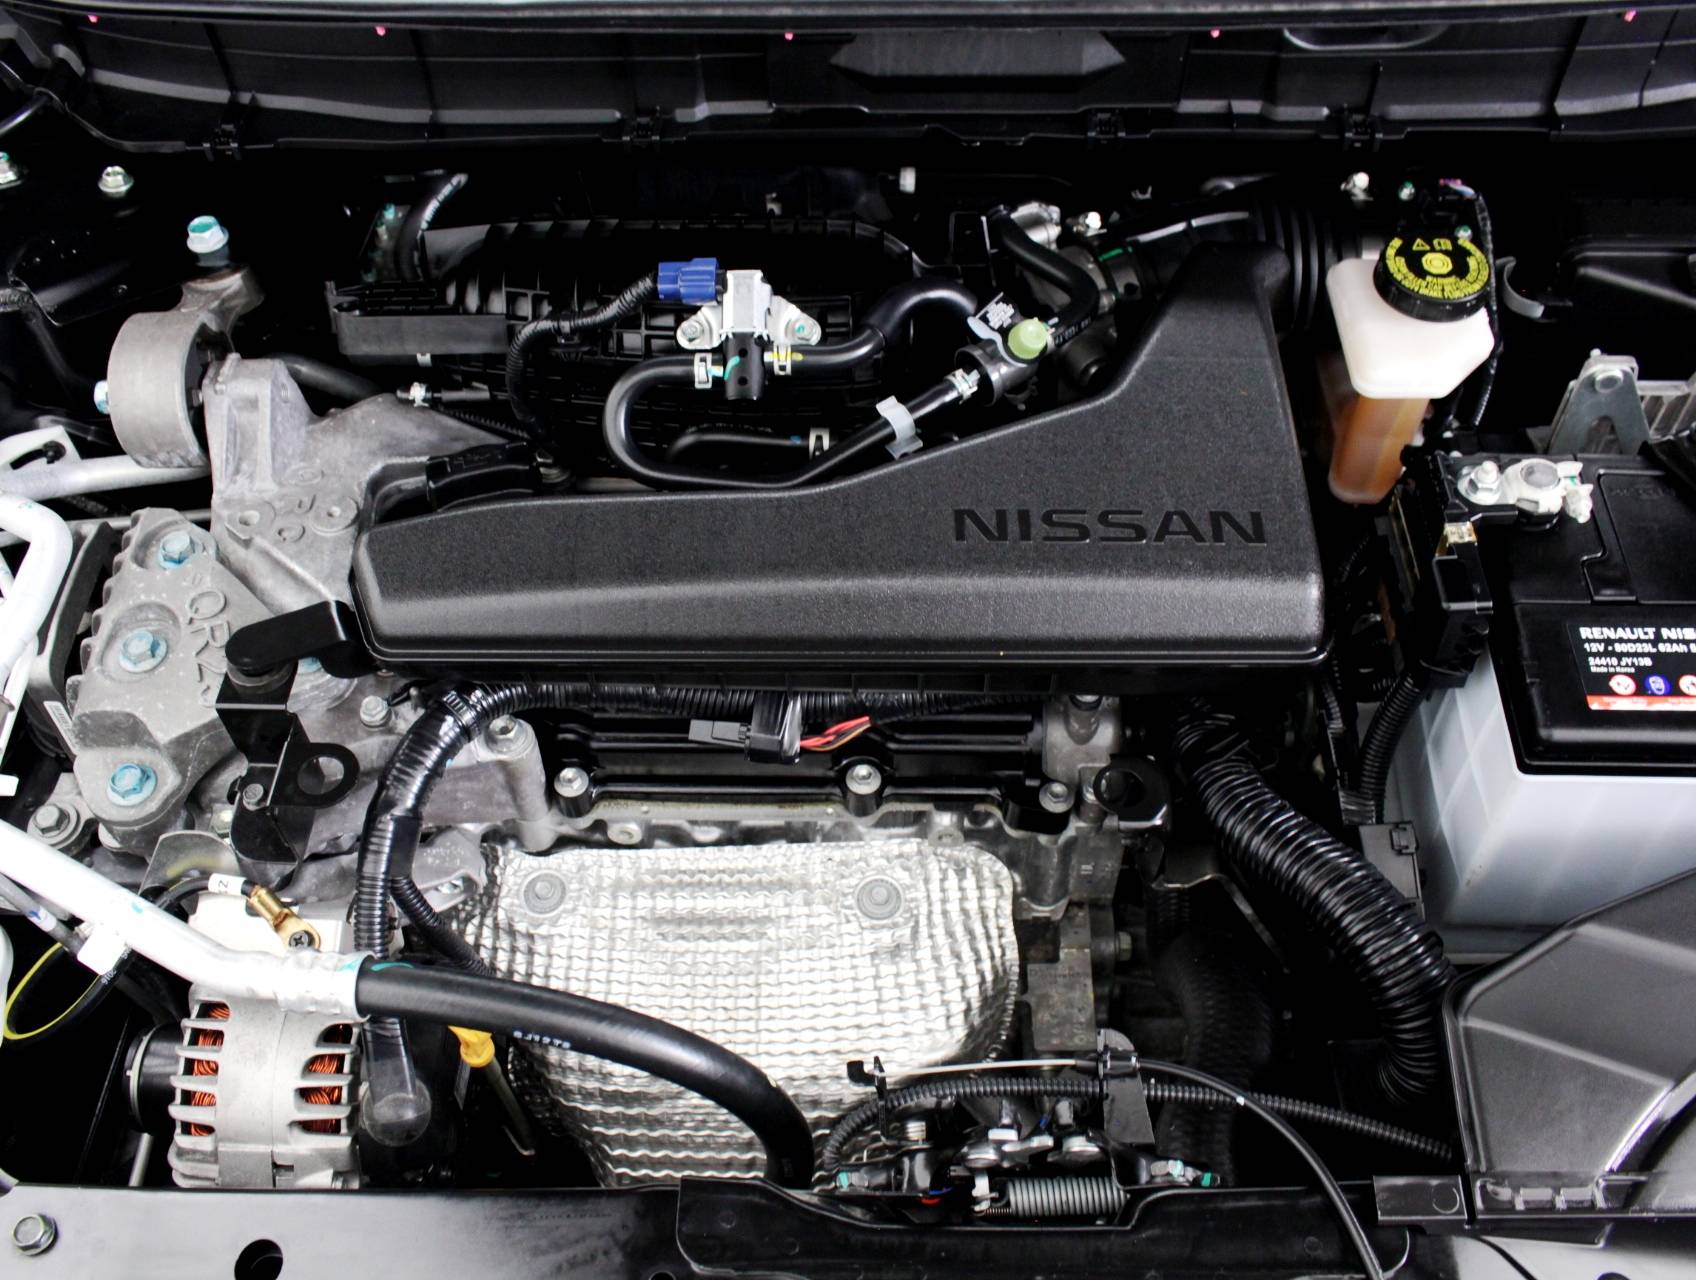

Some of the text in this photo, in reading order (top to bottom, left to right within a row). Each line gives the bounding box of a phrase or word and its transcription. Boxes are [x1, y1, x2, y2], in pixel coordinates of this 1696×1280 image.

[953, 508, 1267, 547] NISSAN
[1579, 627, 1696, 639] RENAULT NIS
[1584, 643, 1604, 652] 12V
